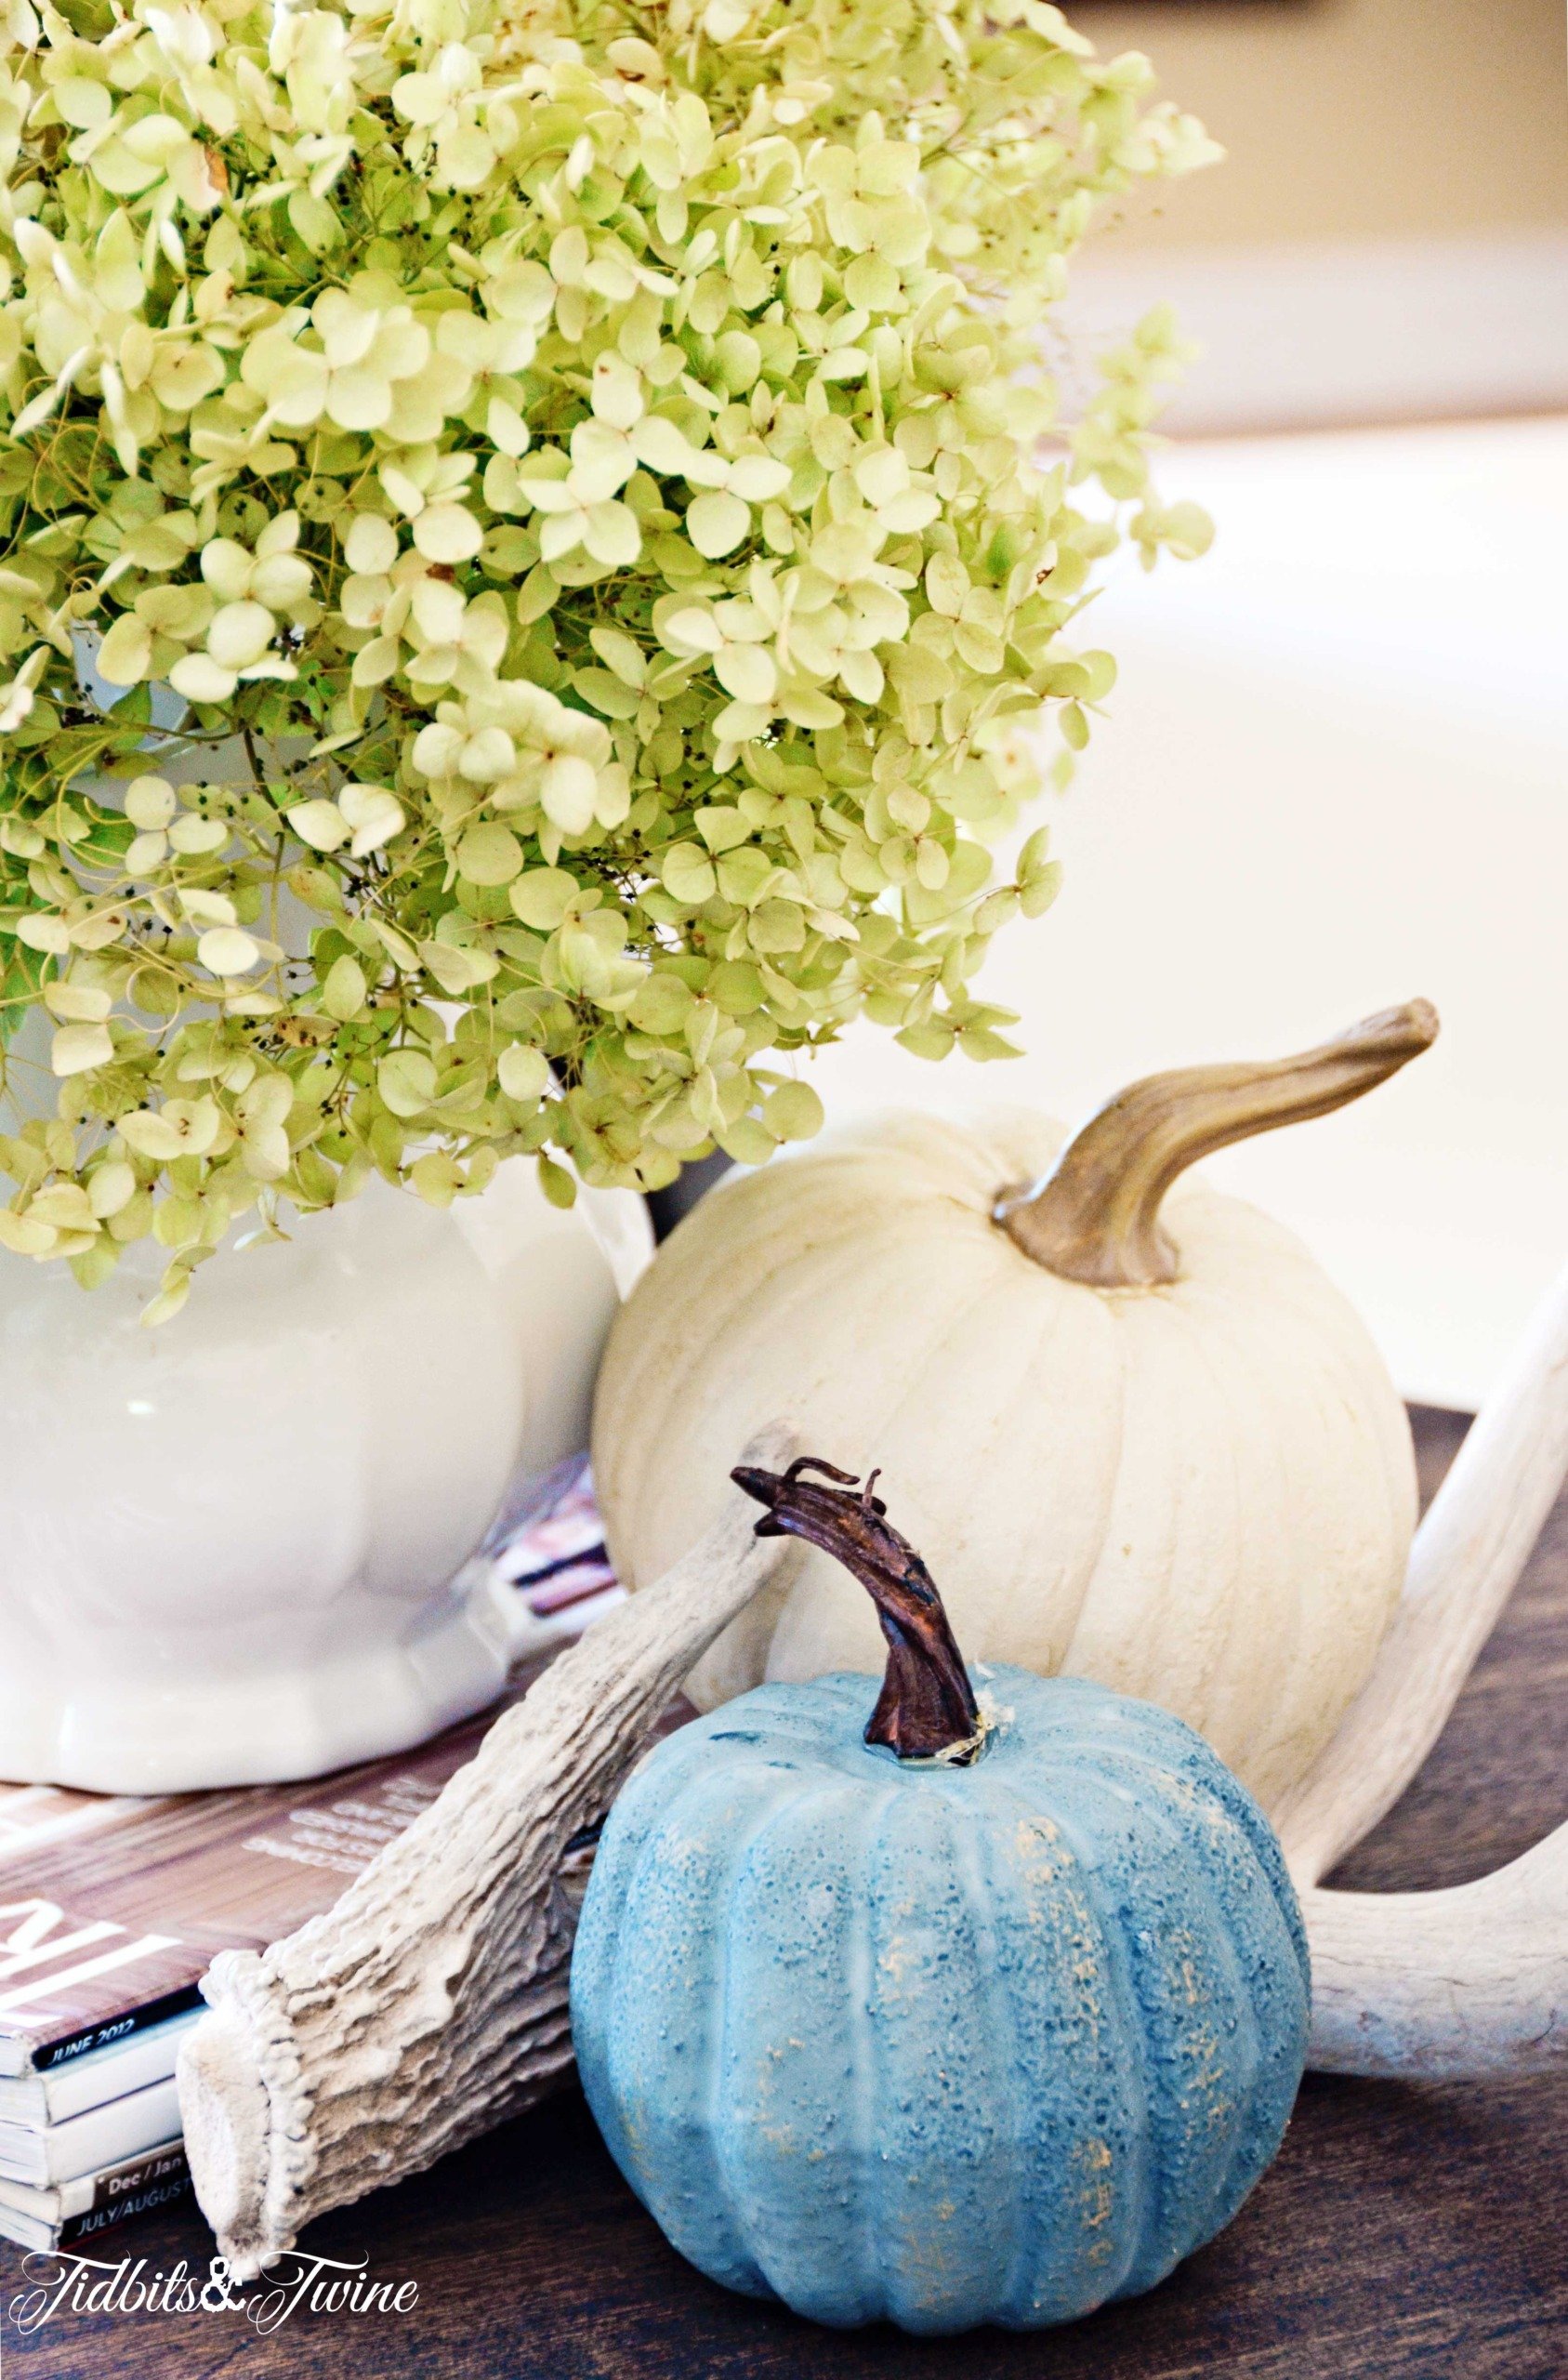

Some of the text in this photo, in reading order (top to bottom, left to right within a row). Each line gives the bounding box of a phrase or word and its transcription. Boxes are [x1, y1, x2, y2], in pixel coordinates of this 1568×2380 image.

[48, 2018, 135, 2065] JUNE 2012
[108, 2175, 139, 2195] Dec
[153, 2156, 183, 2177] Jan
